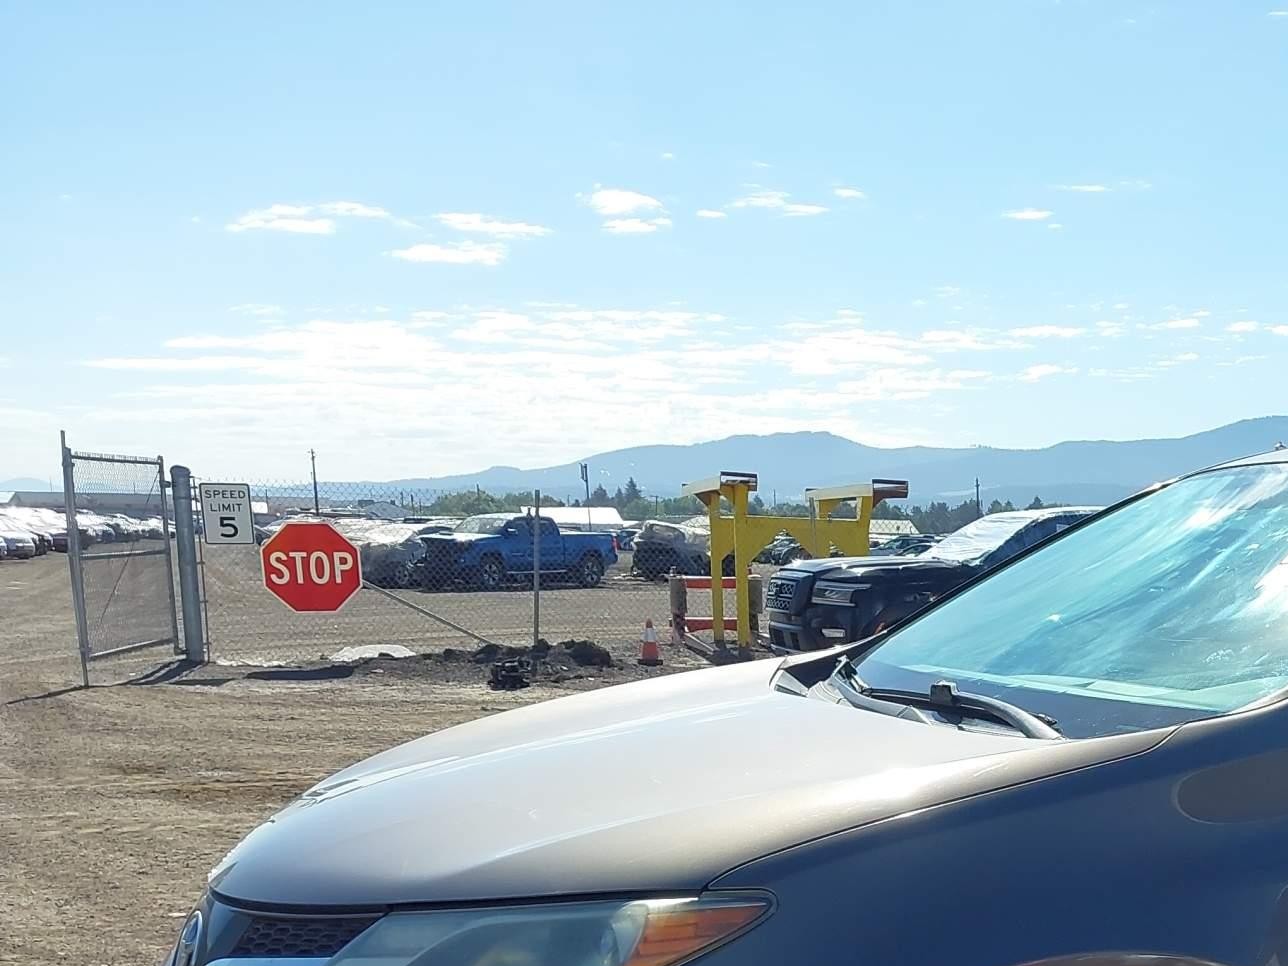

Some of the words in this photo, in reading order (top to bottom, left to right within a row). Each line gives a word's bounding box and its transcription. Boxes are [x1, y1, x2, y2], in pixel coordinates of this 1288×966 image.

[204, 489, 246, 499] SPEED
[210, 503, 243, 512] LIMIT
[219, 516, 239, 538] 5
[269, 551, 353, 585] STOP
